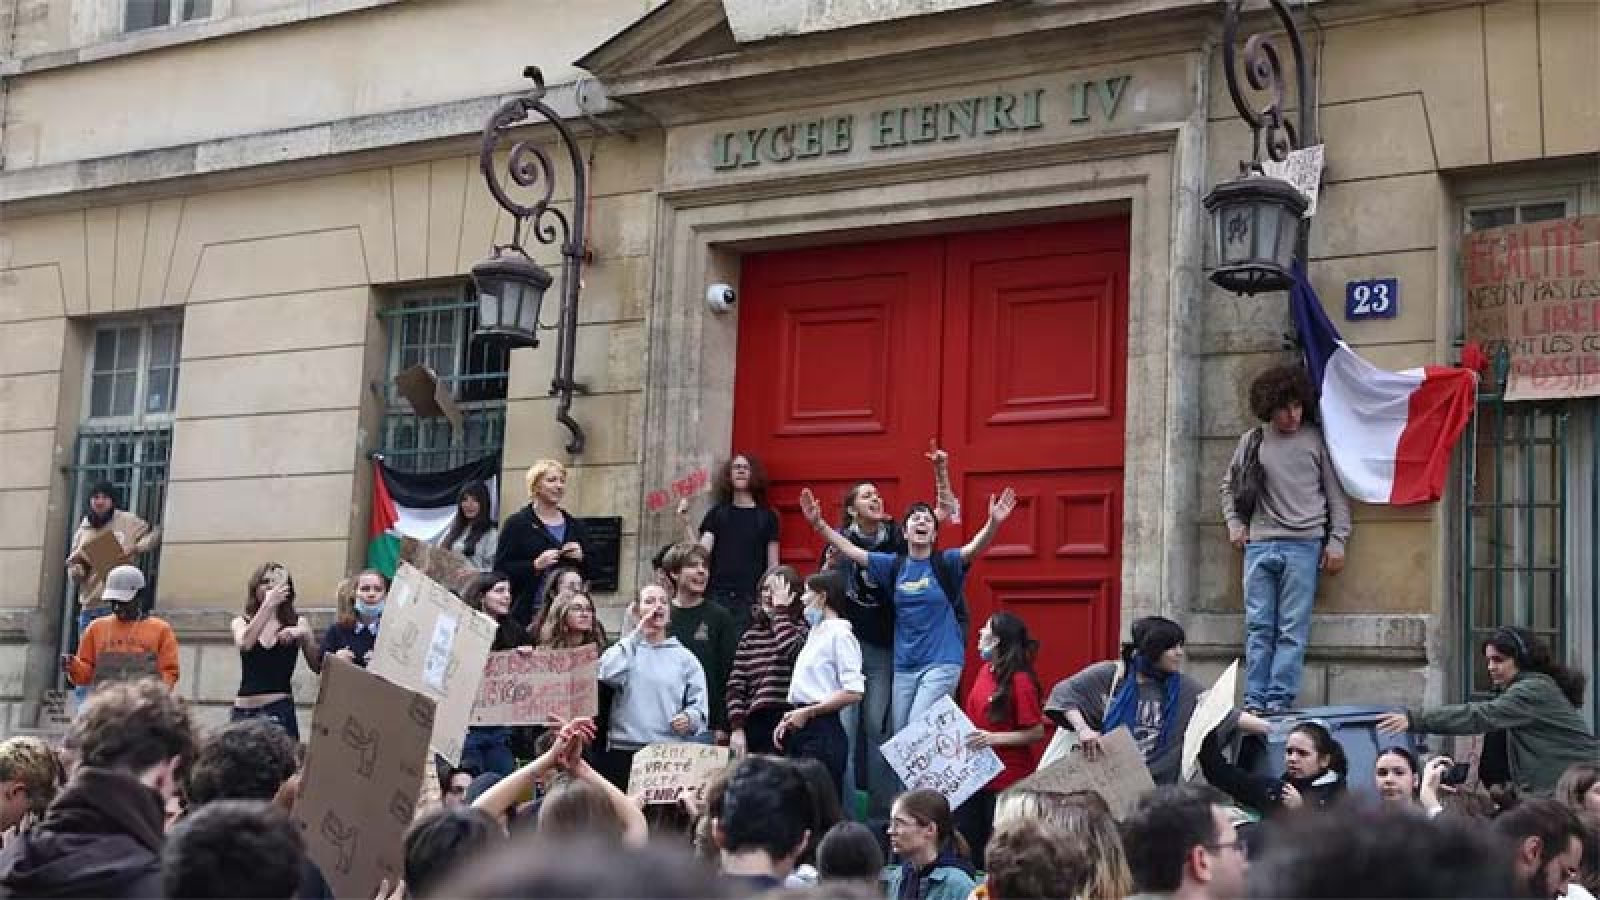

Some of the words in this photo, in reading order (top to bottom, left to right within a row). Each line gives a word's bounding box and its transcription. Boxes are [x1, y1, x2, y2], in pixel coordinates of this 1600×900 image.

[713, 114, 855, 171] LYCEE
[870, 88, 1046, 150] HENRI
[1069, 75, 1132, 125] IV
[1353, 283, 1390, 314] 23
[1541, 335, 1574, 355] LES
